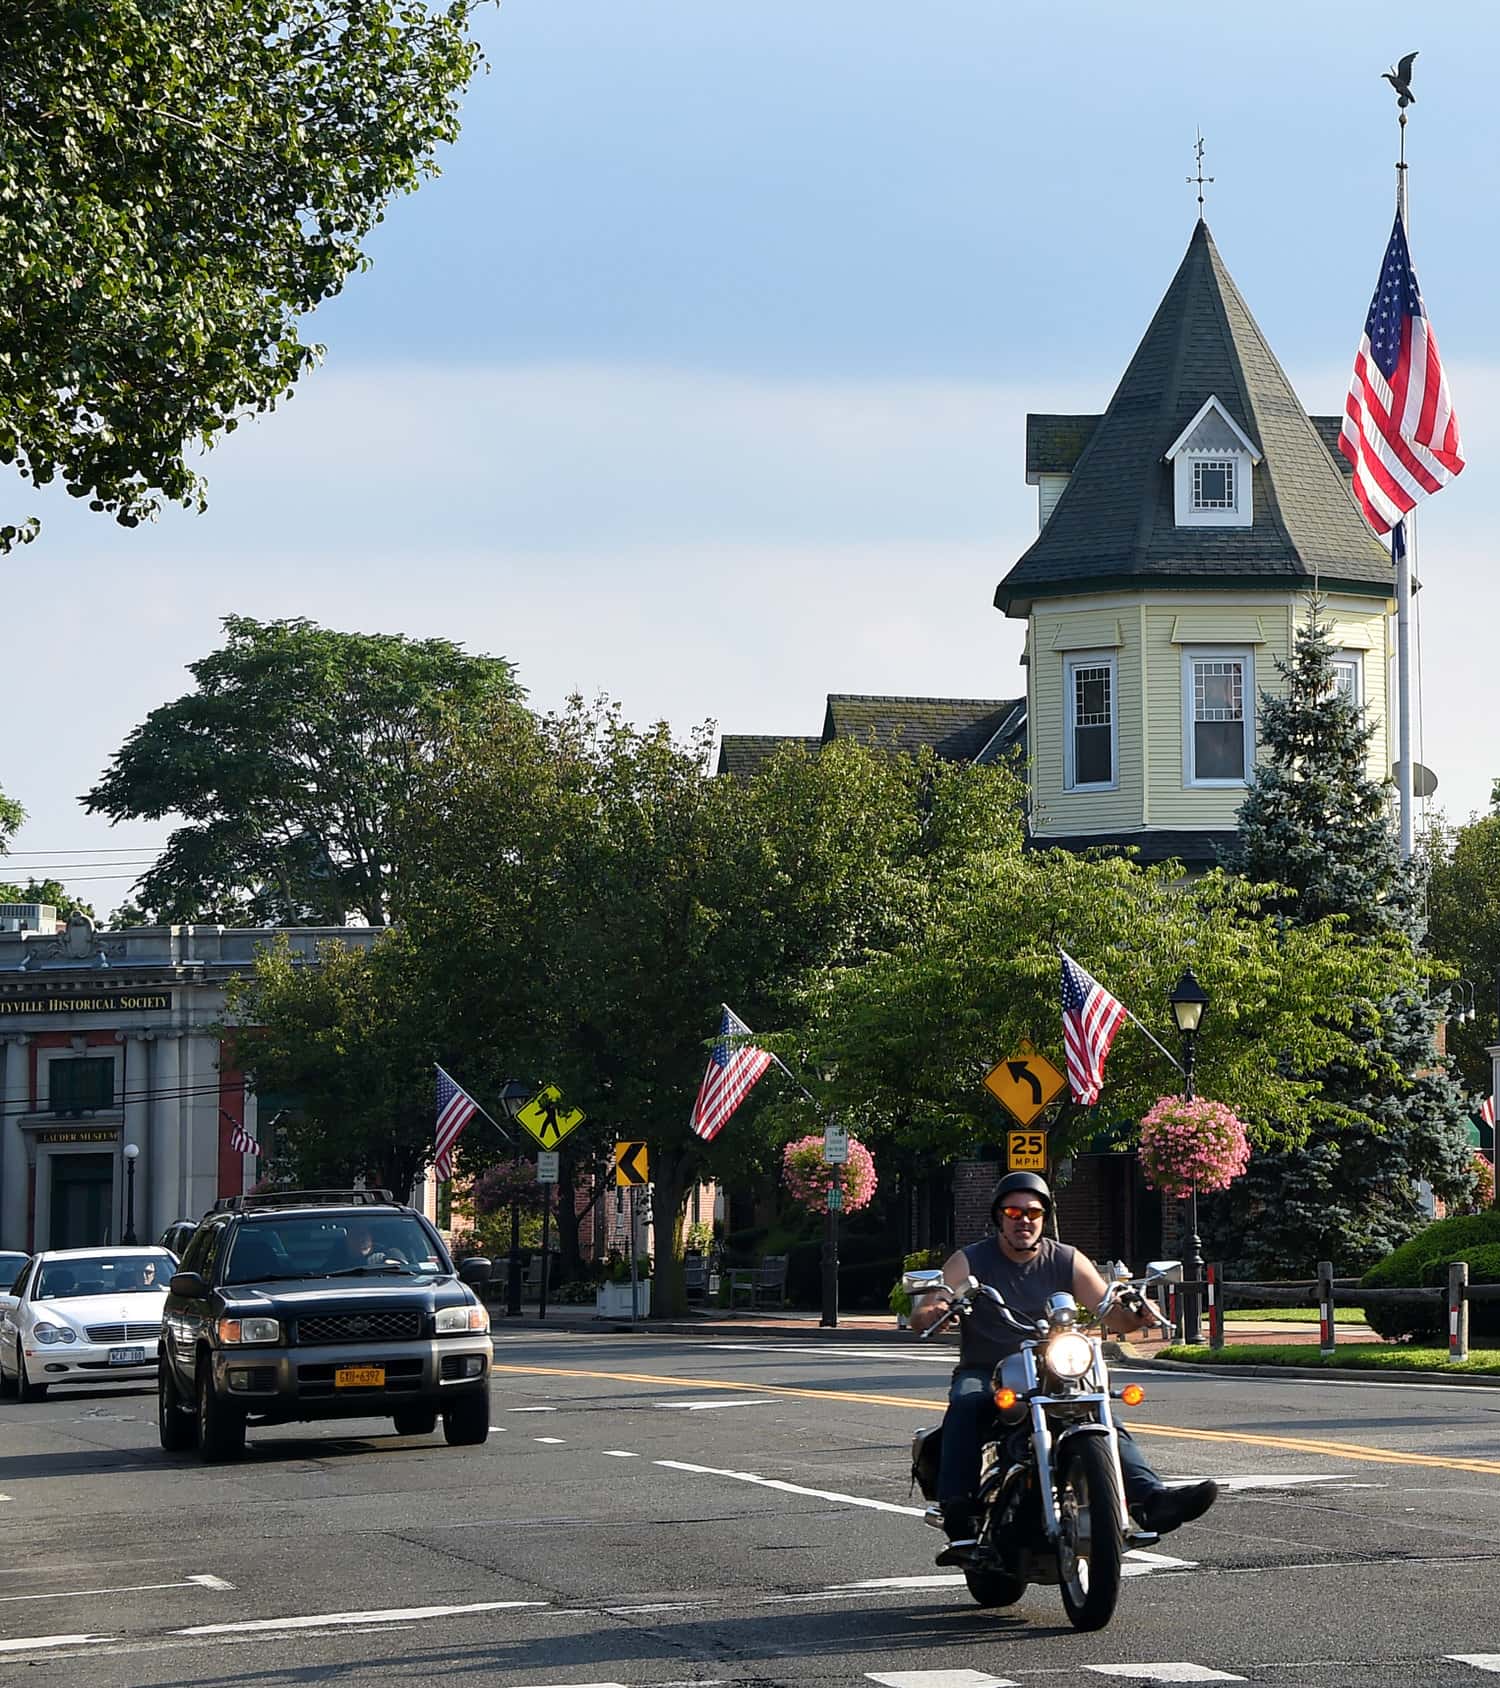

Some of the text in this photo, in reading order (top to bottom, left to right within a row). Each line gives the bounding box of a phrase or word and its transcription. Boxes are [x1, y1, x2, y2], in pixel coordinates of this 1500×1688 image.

[50, 999, 116, 1011] HISTORICAL
[120, 996, 168, 1009] SOCIETY
[1012, 1136, 1042, 1155] 25
[1016, 1158, 1039, 1166] MPH
